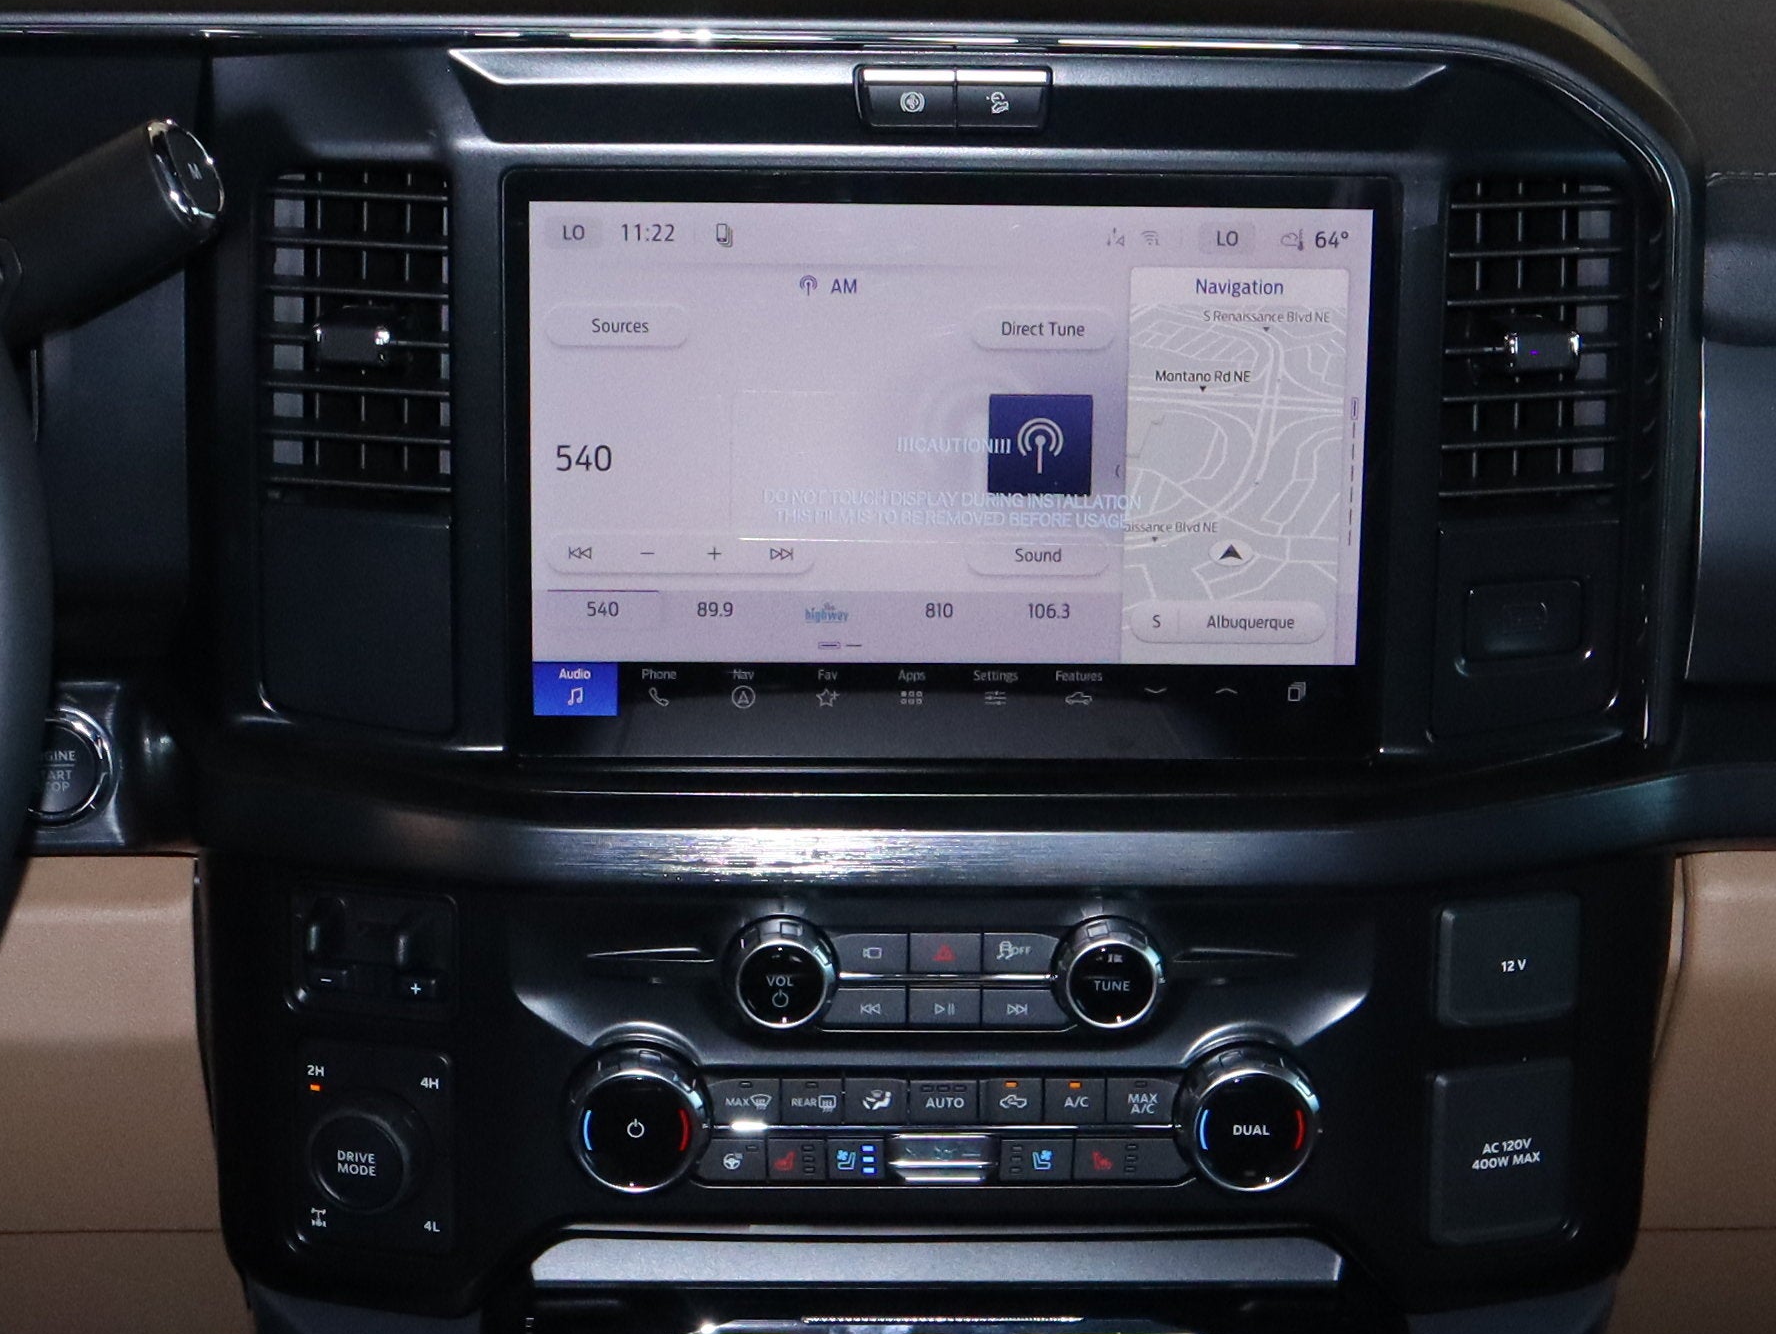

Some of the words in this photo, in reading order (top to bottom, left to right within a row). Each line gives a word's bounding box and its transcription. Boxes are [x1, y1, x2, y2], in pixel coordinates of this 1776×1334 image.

[562, 224, 585, 241] LO
[622, 223, 675, 242] 11:22
[1216, 230, 1239, 247] LO
[830, 278, 858, 294] AM
[1195, 278, 1284, 298] Navigation
[1213, 310, 1284, 324] Renaissance
[1286, 310, 1313, 324] Blvd
[1314, 311, 1331, 324] NE
[591, 318, 649, 334] Sources
[1001, 321, 1044, 337] Direct
[1049, 322, 1086, 338] Tune
[1155, 369, 1212, 384] Montano
[1214, 369, 1231, 383] Rd
[1233, 370, 1251, 384] NE
[556, 444, 613, 472] 540
[762, 488, 788, 504] DO
[791, 489, 827, 505] NOT
[830, 489, 886, 506] TOUCH
[889, 490, 959, 507] DISPLAY
[961, 492, 1025, 509] DURING
[1027, 493, 1142, 511] INSTALLATION
[924, 510, 1007, 527] REMOVED
[1009, 511, 1073, 528] BEFORE
[1174, 521, 1200, 534] Blvd
[1202, 521, 1219, 533] NE
[1014, 548, 1062, 563] Sound
[587, 601, 619, 617] 540
[696, 602, 734, 618] 89.9
[925, 602, 954, 618] 810
[1027, 603, 1070, 619] 106.3
[1152, 614, 1161, 629] S
[1206, 615, 1295, 632] Albuquerque
[558, 668, 592, 680] Audio
[641, 669, 677, 680] Phone
[733, 669, 755, 680] Nav
[818, 669, 838, 680] Fav
[898, 670, 926, 683] Apps
[973, 670, 1019, 683] Settings
[1055, 670, 1103, 682] Features
[1500, 959, 1515, 973] 12
[1517, 958, 1527, 971] V
[765, 975, 794, 987] VOL
[1093, 980, 1131, 992] TUNE
[307, 1064, 325, 1077] 2H
[420, 1077, 439, 1090] 4H
[725, 1097, 750, 1108] MAX
[791, 1096, 817, 1108] REAR
[925, 1097, 965, 1109] AUTO
[1064, 1095, 1089, 1109] A/C
[1127, 1093, 1158, 1105] MAX
[1130, 1102, 1155, 1115] A/C
[1232, 1124, 1271, 1136] DUAL
[1481, 1142, 1500, 1155] AC
[1502, 1137, 1533, 1152] 120V
[337, 1149, 375, 1165] DRIVE
[1471, 1155, 1510, 1171] 400W
[1511, 1151, 1541, 1166] MAX
[337, 1162, 376, 1177] MODE
[423, 1220, 441, 1233] 4L
